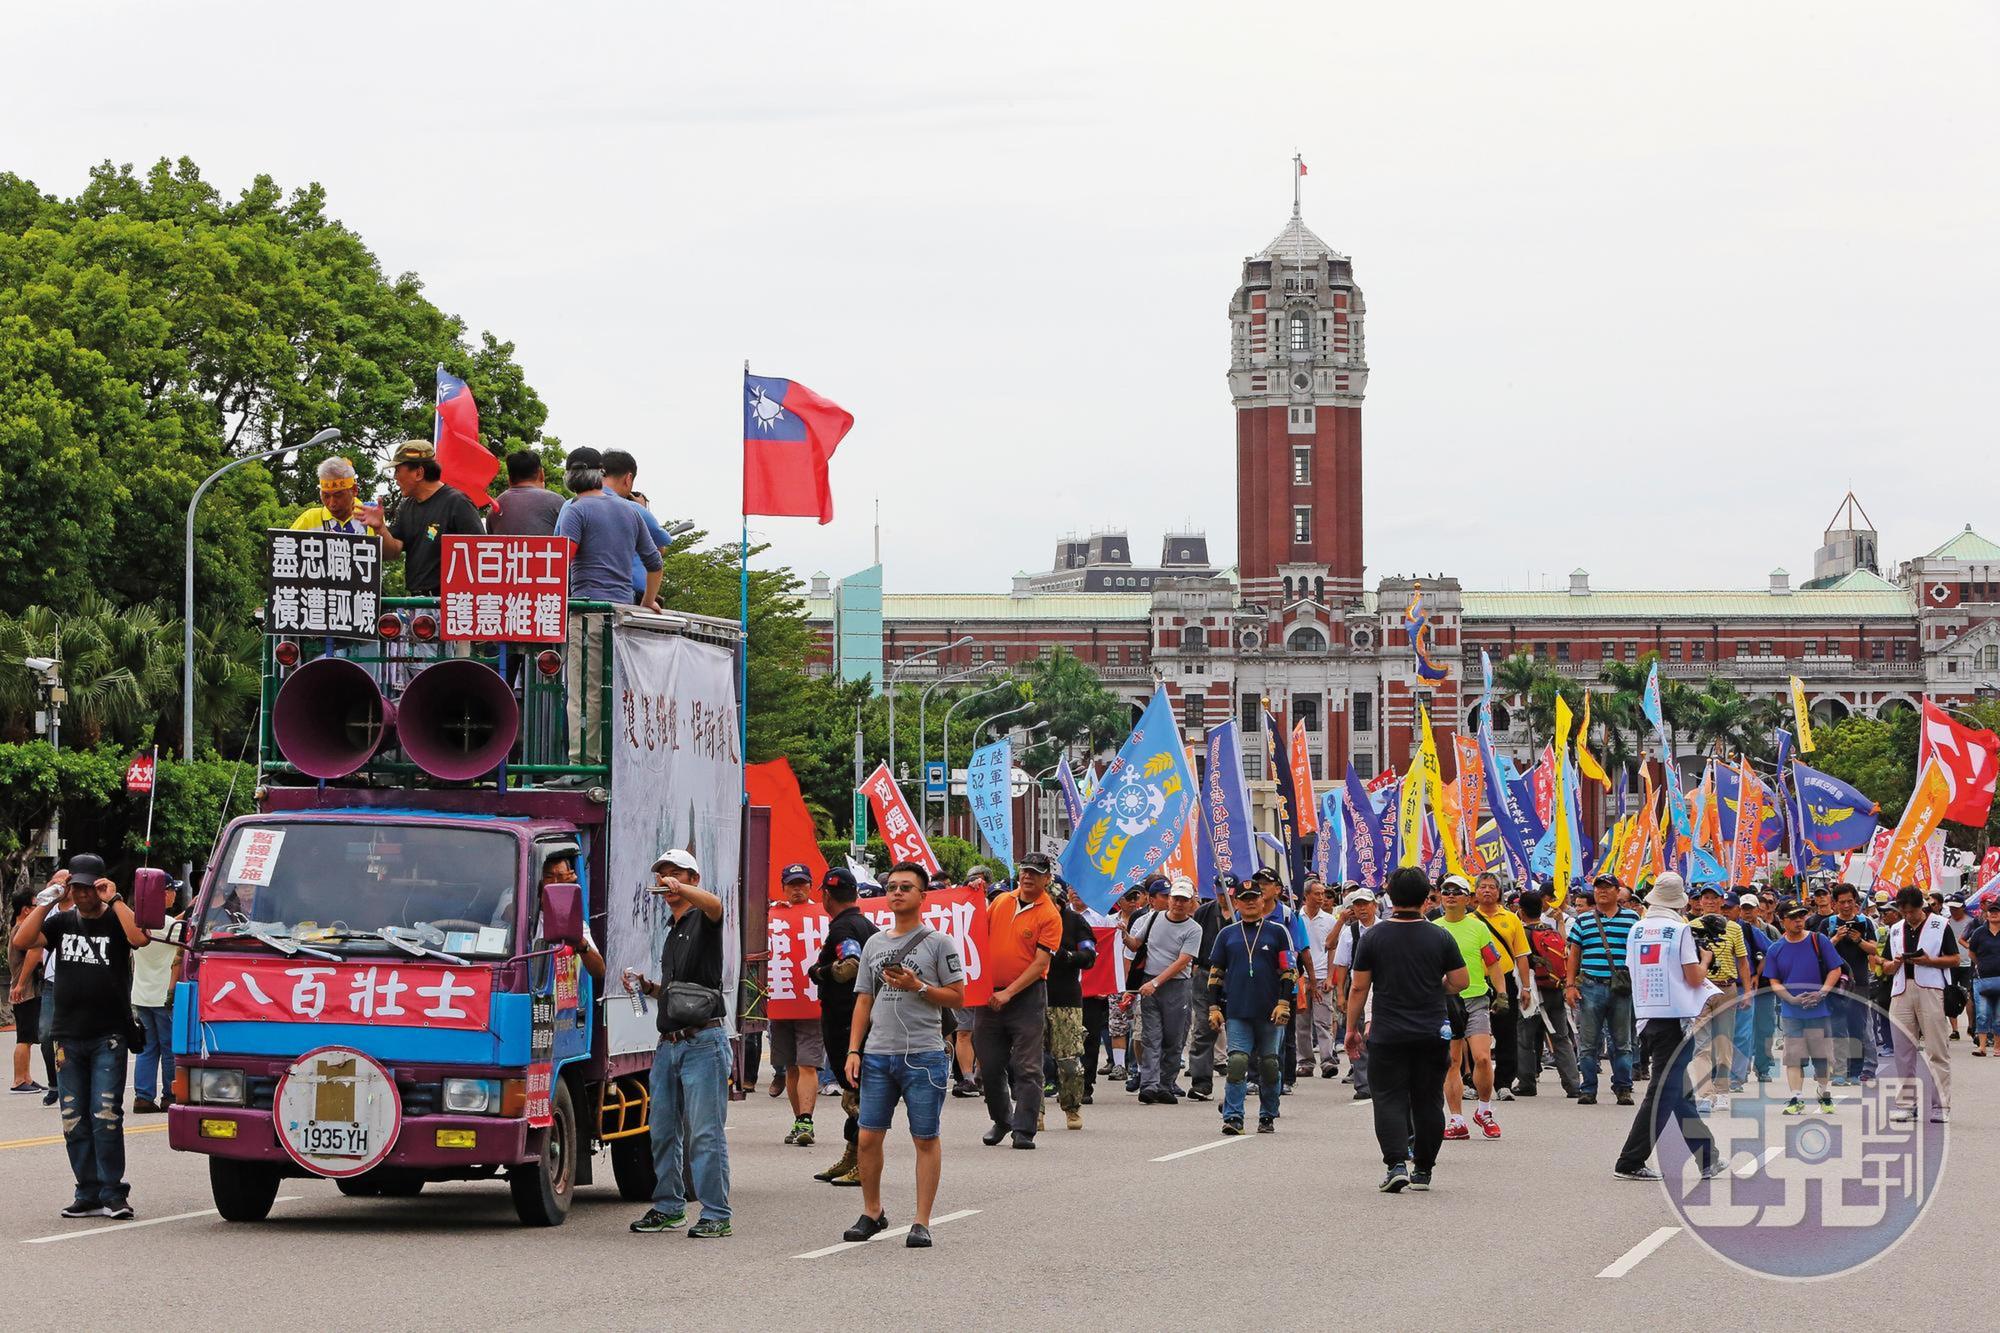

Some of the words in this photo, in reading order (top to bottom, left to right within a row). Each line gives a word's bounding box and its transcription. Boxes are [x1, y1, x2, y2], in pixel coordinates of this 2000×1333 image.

[272, 535, 377, 584] 盡忠職守
[446, 541, 562, 585] 八百壯士
[446, 591, 561, 637] 護憲維權
[239, 831, 275, 881] 暫緩實施
[62, 933, 110, 959] KMT
[211, 966, 475, 1019] 八百壯士
